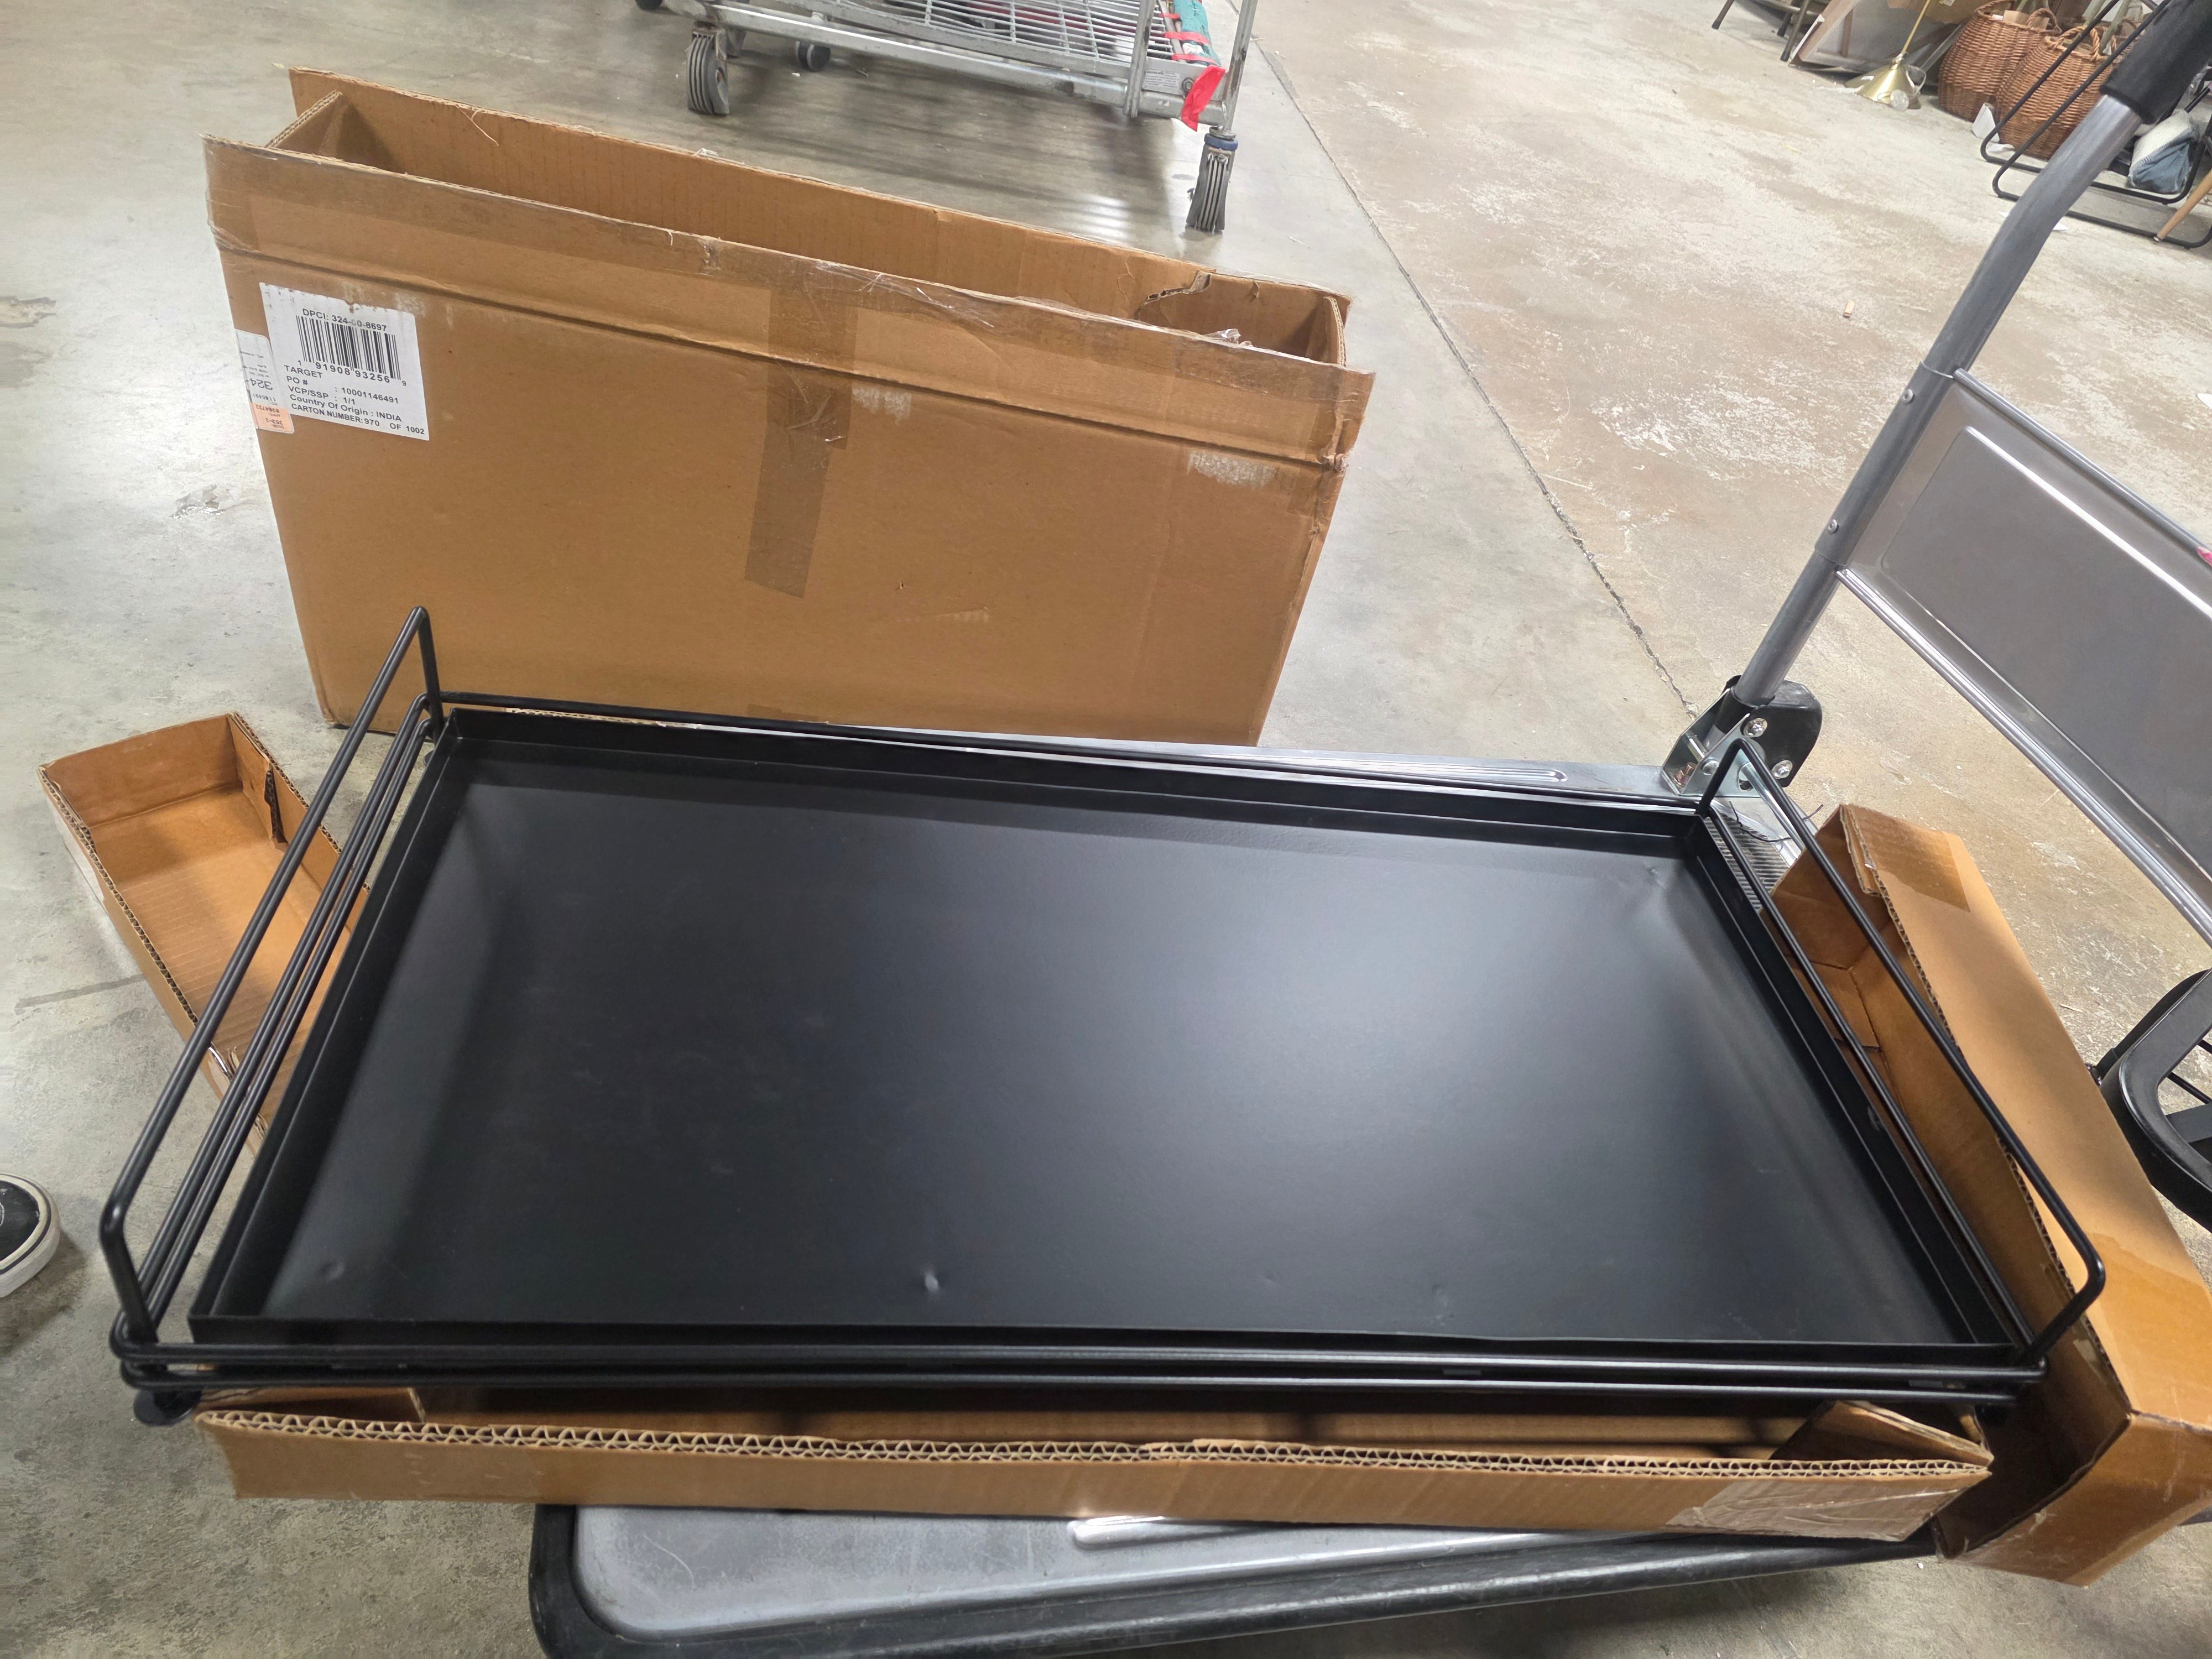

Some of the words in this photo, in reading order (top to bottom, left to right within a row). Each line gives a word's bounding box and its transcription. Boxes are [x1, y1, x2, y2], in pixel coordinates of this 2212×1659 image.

[302, 308, 329, 320] DPCI:
[284, 364, 322, 379] TARGET
[286, 375, 300, 384] PO
[341, 387, 399, 404] 10001146491
[288, 385, 328, 399] VCP/SSP
[343, 397, 356, 405] 1/1
[290, 394, 325, 408] Country
[341, 404, 368, 416] Origin
[376, 411, 402, 422] INDIA
[291, 403, 325, 416] CARTON
[406, 425, 425, 435] 1002
